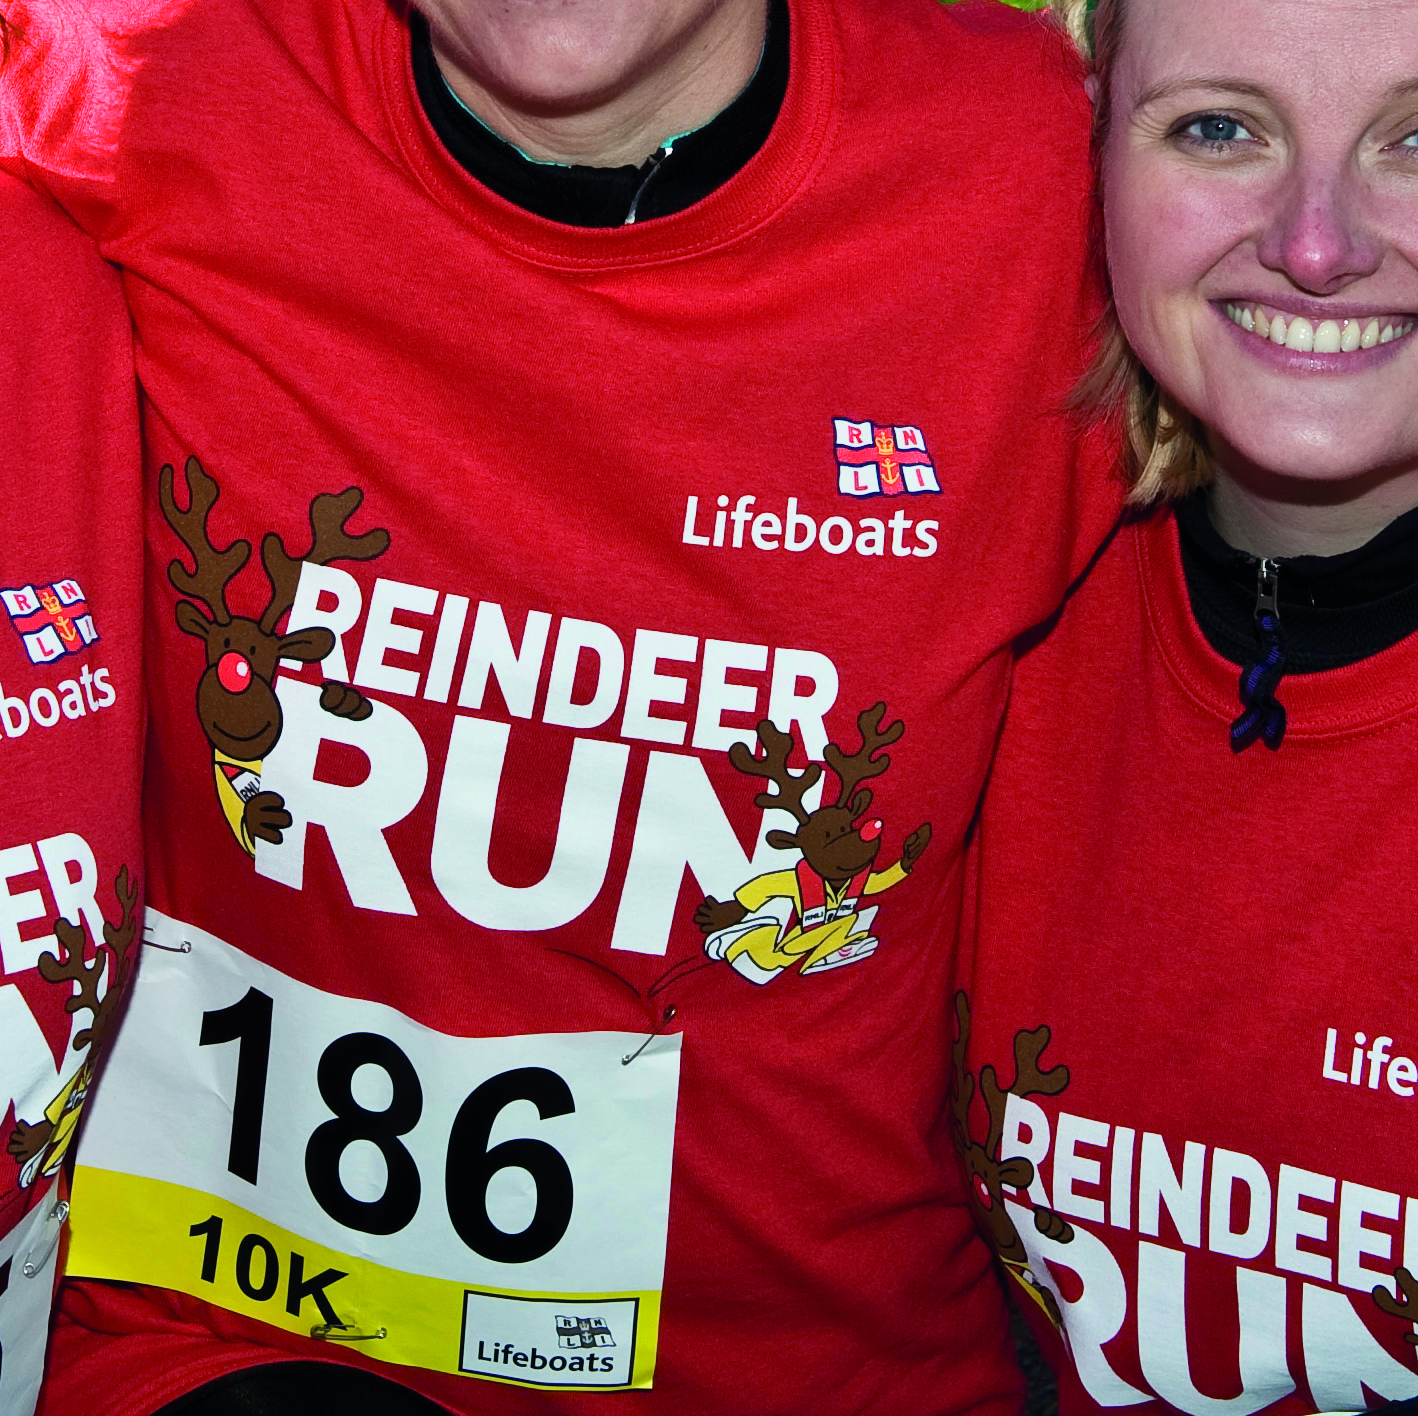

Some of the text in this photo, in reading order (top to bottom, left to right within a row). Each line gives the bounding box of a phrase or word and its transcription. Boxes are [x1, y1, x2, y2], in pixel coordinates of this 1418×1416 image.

[682, 494, 940, 558] Lifeboats
[281, 561, 839, 761] REINDEER
[254, 675, 827, 957] RUN
[199, 986, 576, 1264] 186
[189, 1215, 350, 1331] 10K
[478, 1340, 614, 1372] Lifeboats
